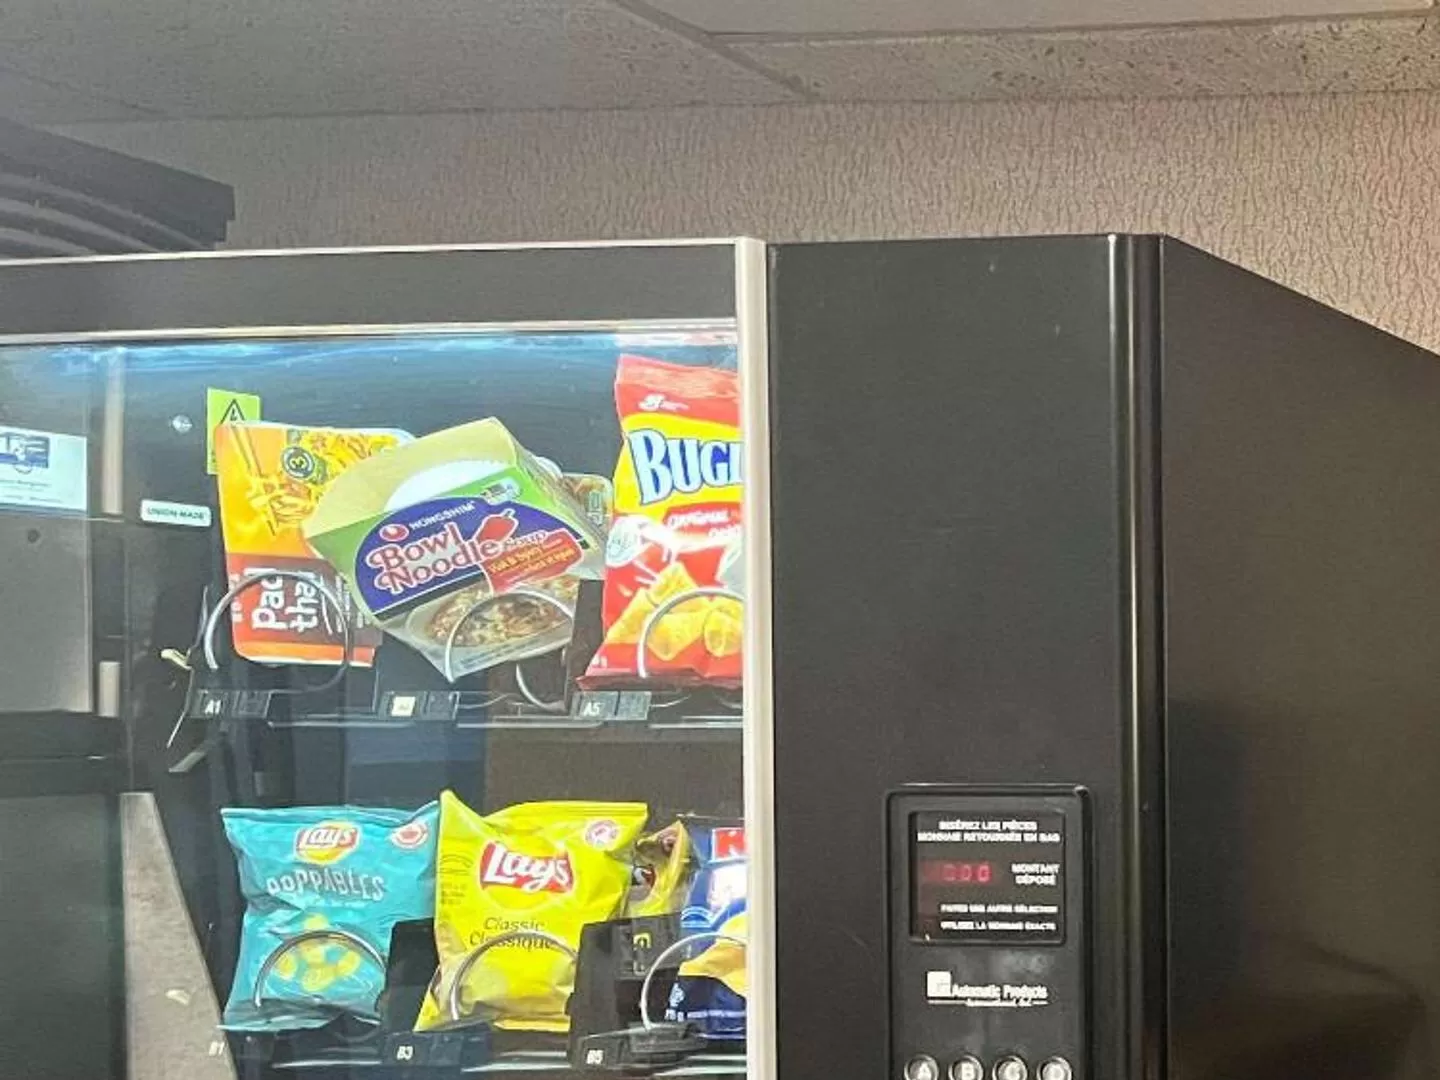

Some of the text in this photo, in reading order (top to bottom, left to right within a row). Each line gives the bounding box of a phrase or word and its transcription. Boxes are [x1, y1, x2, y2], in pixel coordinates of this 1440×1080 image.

[365, 521, 464, 571] Bowl
[374, 537, 503, 594] Noodle
[205, 700, 221, 714] A1
[481, 842, 572, 891] Lay's
[469, 929, 560, 953] Clssique
[483, 916, 546, 932] Classic
